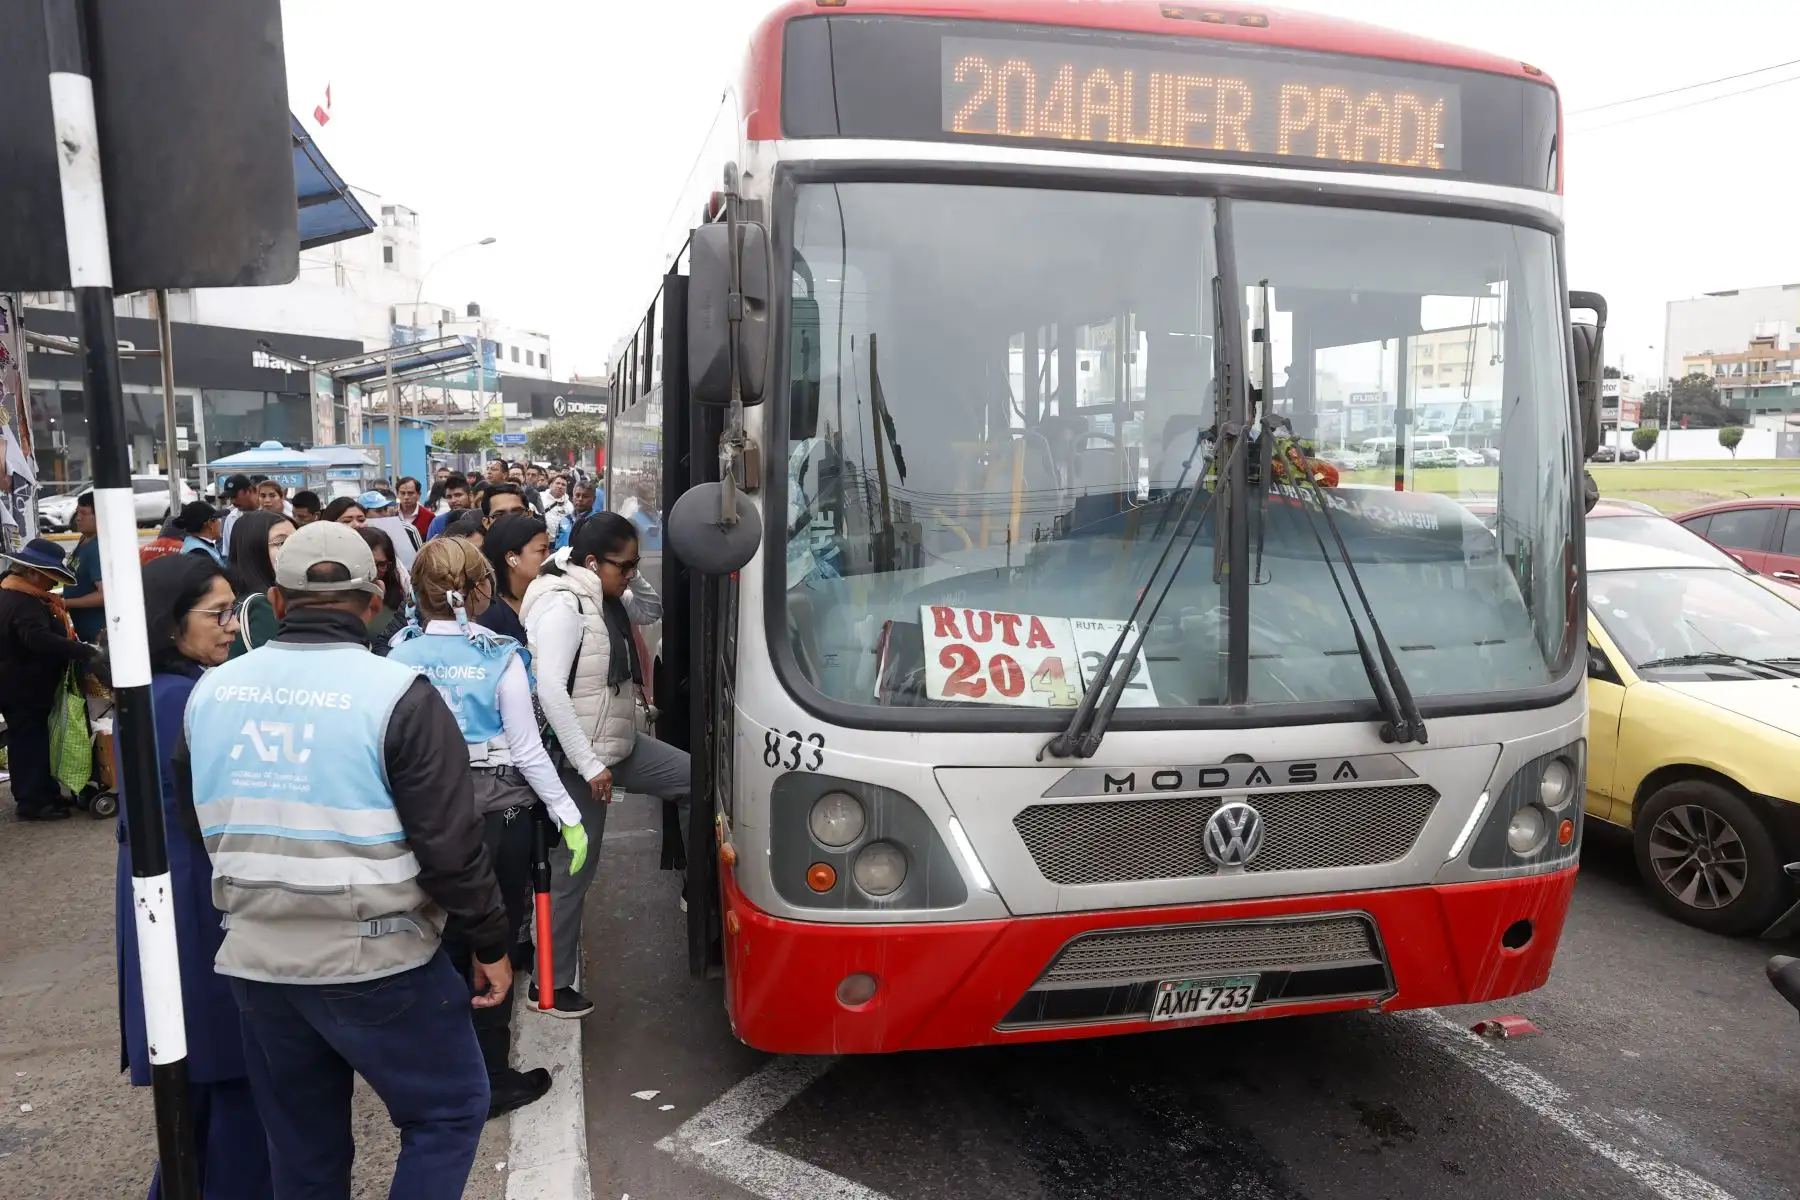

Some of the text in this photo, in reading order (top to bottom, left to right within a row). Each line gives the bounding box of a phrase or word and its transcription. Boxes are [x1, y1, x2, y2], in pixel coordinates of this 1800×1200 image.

[931, 606, 1055, 649] RUTA
[1076, 621, 1104, 631] RUTA
[410, 665, 487, 680] ERACIONES
[938, 643, 1079, 707] 204
[214, 685, 353, 710] OPERACIONES
[230, 718, 315, 764] ATU
[763, 727, 826, 772] 833
[1103, 760, 1359, 794] MODASA
[1156, 985, 1252, 1016] AXH-733
